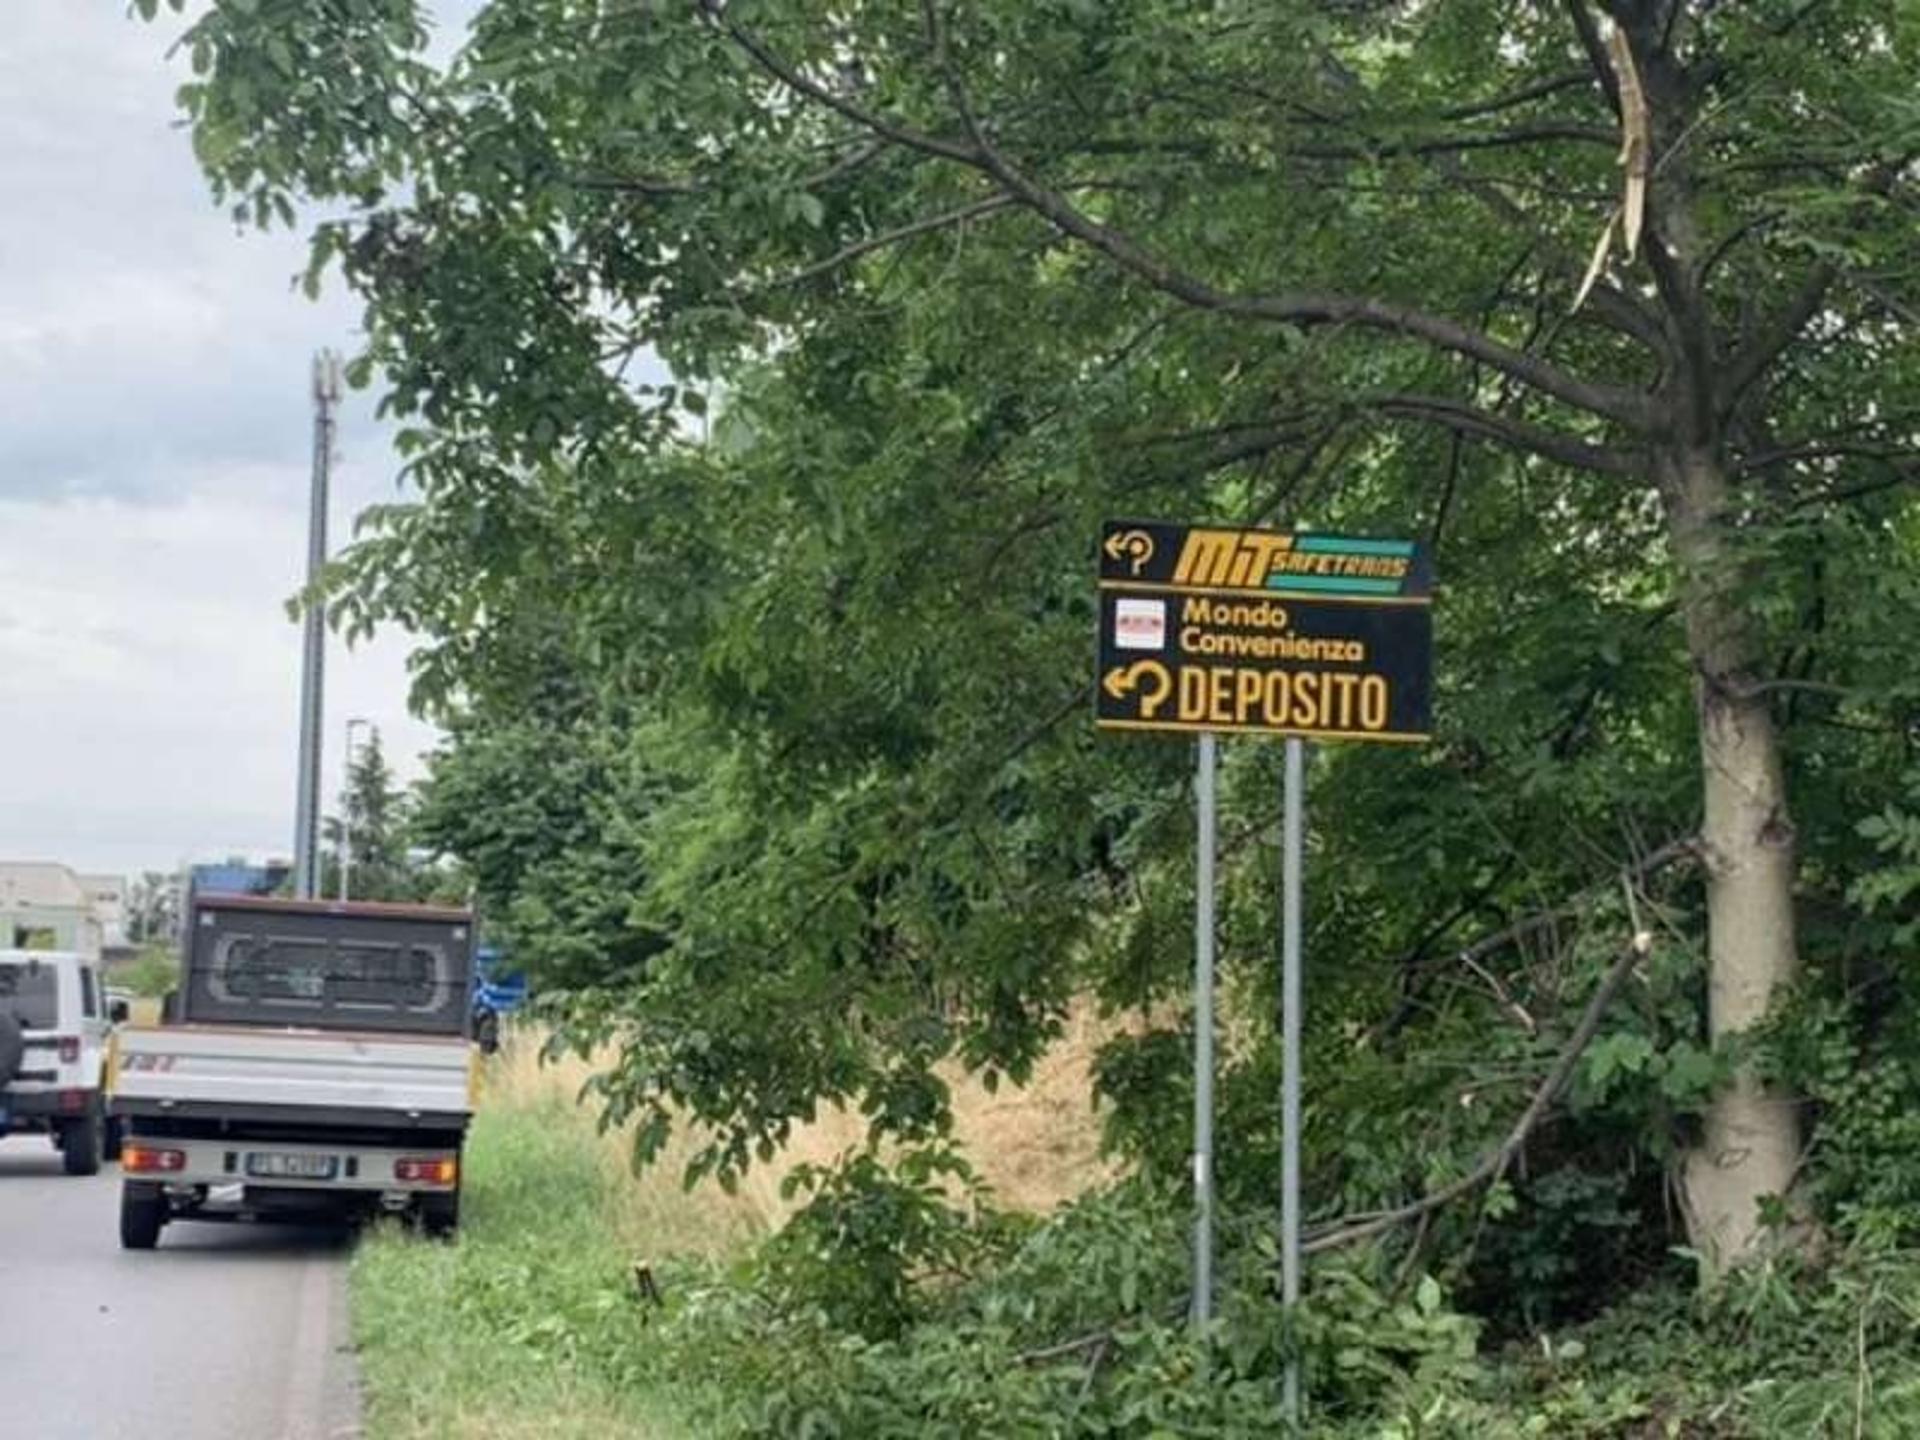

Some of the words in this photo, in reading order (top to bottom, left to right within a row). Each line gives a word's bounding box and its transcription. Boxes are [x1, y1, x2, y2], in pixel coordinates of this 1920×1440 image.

[1182, 597, 1288, 628] Mondo
[1180, 628, 1364, 662] Convenienza
[1178, 666, 1388, 730] DEPOSITO
